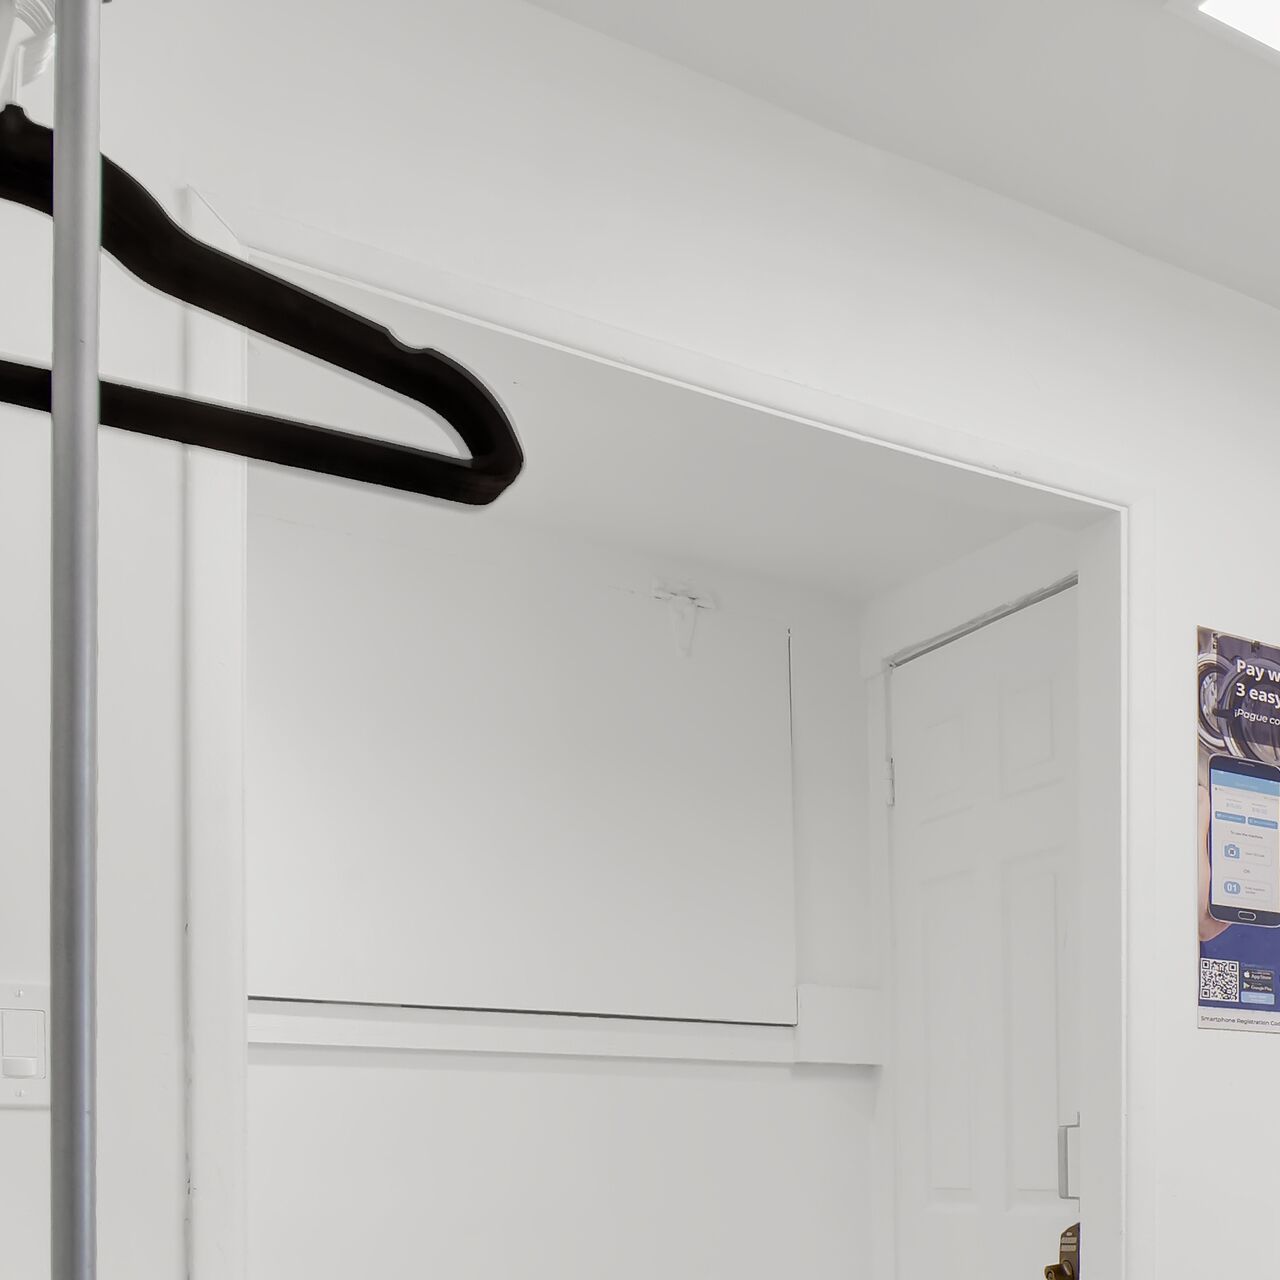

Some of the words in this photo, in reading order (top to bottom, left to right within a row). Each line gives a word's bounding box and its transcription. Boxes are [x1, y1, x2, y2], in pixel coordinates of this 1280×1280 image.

[1236, 659, 1264, 681] Pay
[1236, 682, 1245, 697] 3
[1234, 708, 1268, 722] ¡Pague
[1226, 882, 1237, 893] 01
[1200, 1015, 1236, 1024] Smartphone
[1236, 1018, 1270, 1026] Registration
